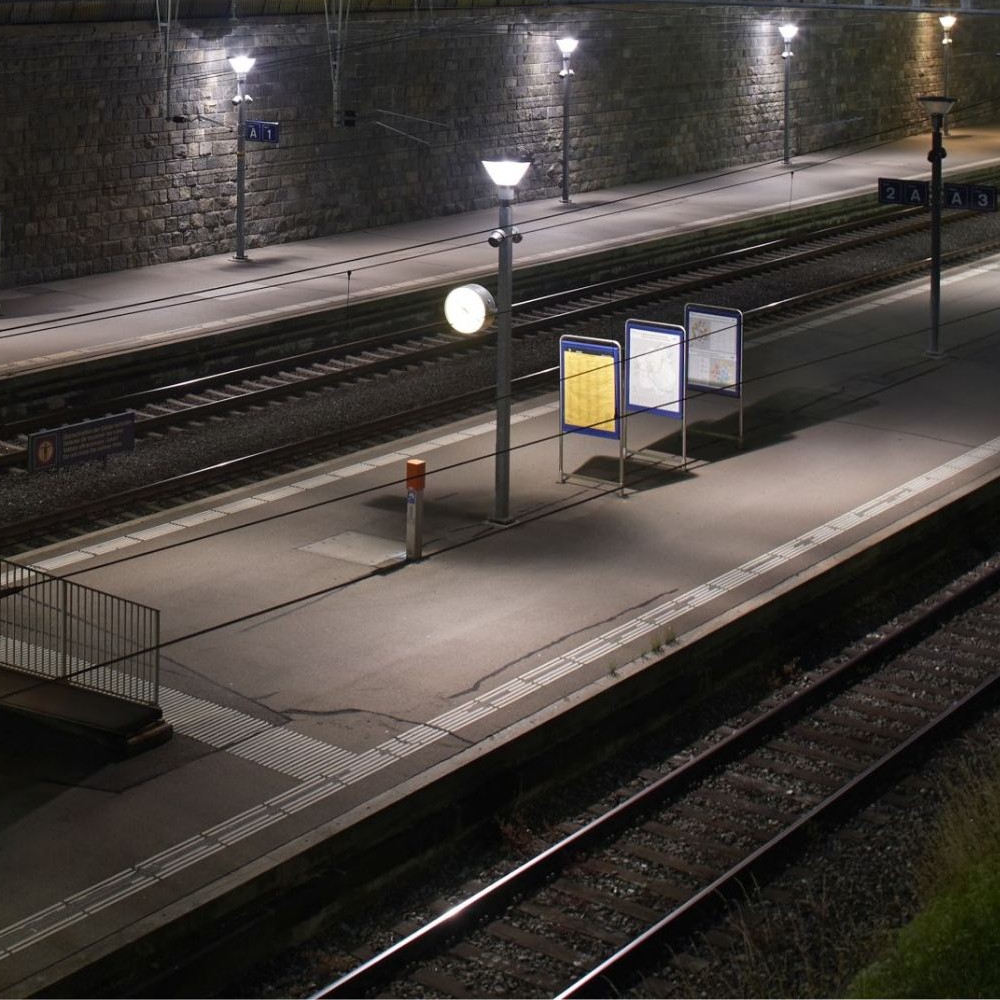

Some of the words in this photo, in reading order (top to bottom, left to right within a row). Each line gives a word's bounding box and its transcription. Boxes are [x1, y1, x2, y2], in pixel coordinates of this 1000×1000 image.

[249, 128, 257, 139] A
[266, 129, 272, 140] 1
[885, 187, 896, 200] 2
[910, 189, 921, 202] A
[951, 192, 962, 206] A
[978, 193, 989, 207] 3
